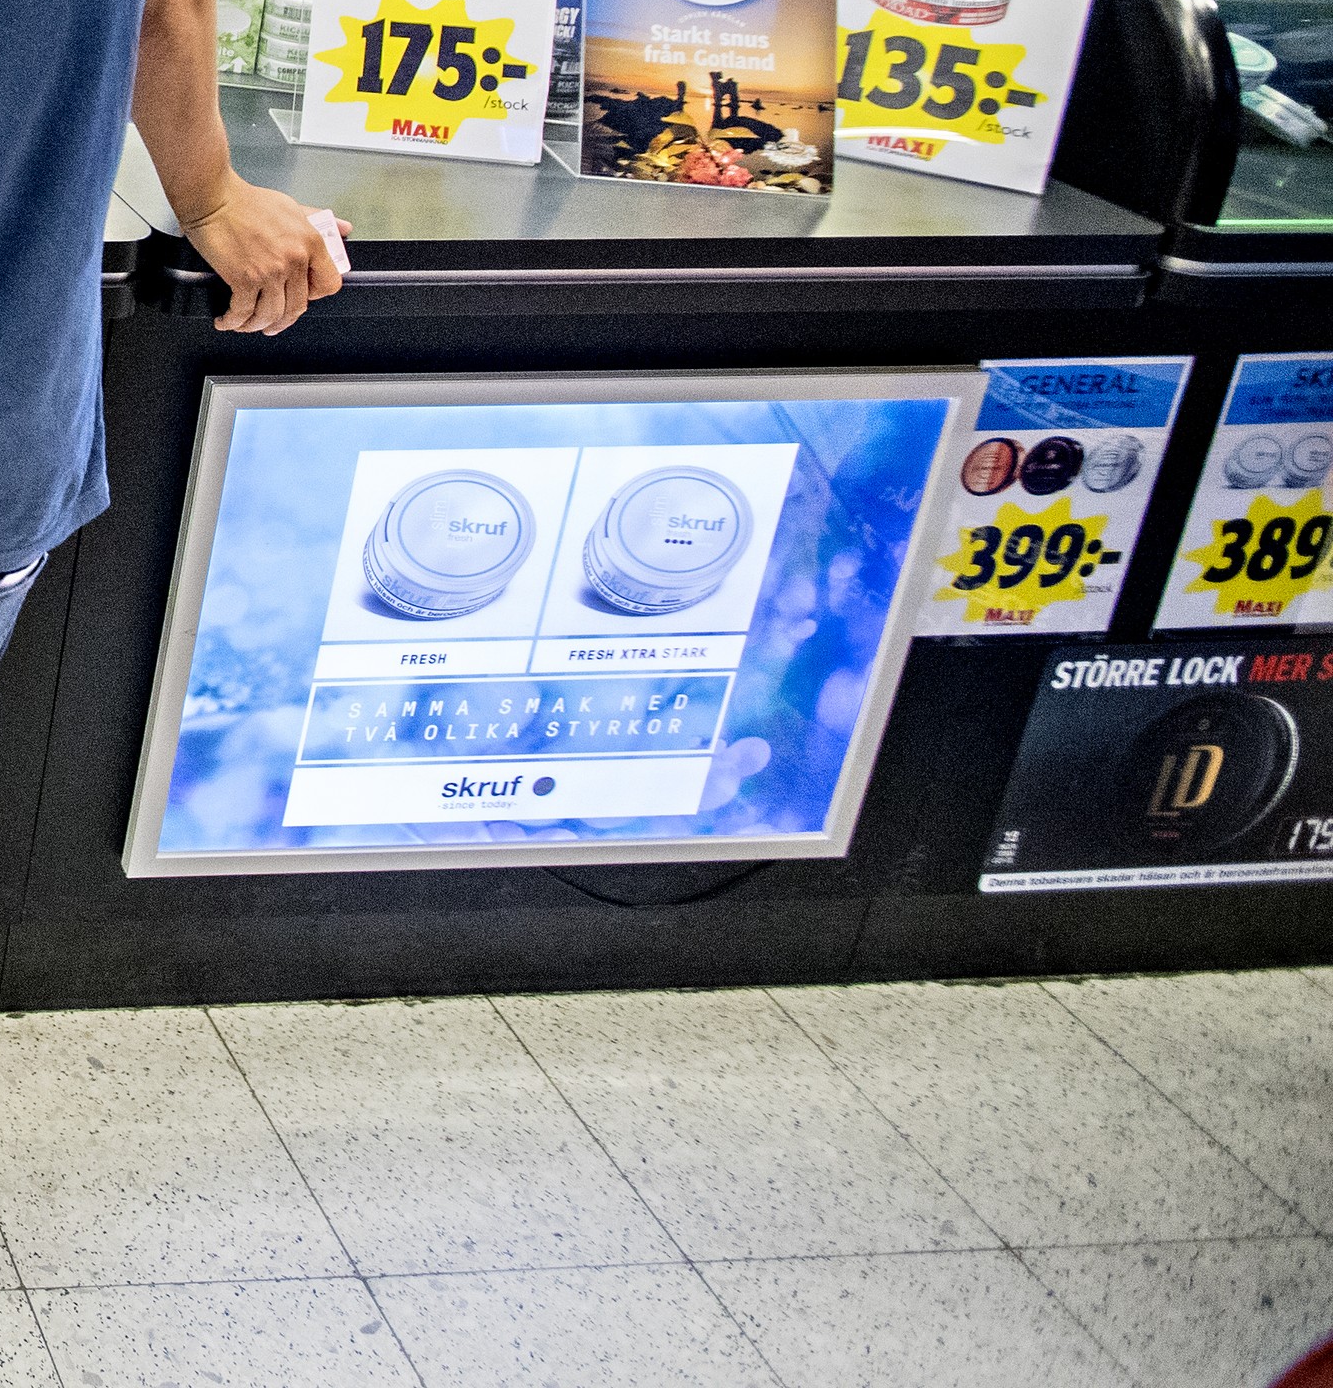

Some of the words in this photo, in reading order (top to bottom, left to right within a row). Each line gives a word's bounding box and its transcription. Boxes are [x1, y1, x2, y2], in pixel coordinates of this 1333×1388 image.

[650, 23, 712, 45] Starkt
[719, 30, 770, 49] snus
[356, 18, 529, 102] 175:-
[644, 44, 687, 66] från
[693, 48, 775, 71] Gotland
[483, 98, 529, 112] /stock
[392, 118, 450, 140] MAXI
[976, 118, 1033, 139] /stock
[867, 136, 934, 156] MAXI
[1019, 369, 1140, 396] GENERAL
[448, 515, 509, 537] skruf
[667, 512, 726, 533] skruf
[952, 523, 1124, 592] 399:-
[983, 608, 1035, 624] MAXI
[400, 654, 447, 665] FRESH
[568, 649, 615, 661] FRESH
[620, 647, 657, 659] XTRA
[662, 647, 709, 659] STARK
[1050, 654, 1164, 689] STÖRRE
[1166, 656, 1244, 686] LOCK
[1249, 654, 1312, 682] MER
[348, 700, 470, 719] SAMMA
[498, 697, 594, 715] SMAK
[620, 694, 690, 711] MED
[344, 721, 398, 743] TVÅ
[423, 722, 520, 741] OLIKA
[545, 718, 683, 738] STYRKOR
[441, 775, 524, 799] skruf
[1147, 744, 1224, 817] LD
